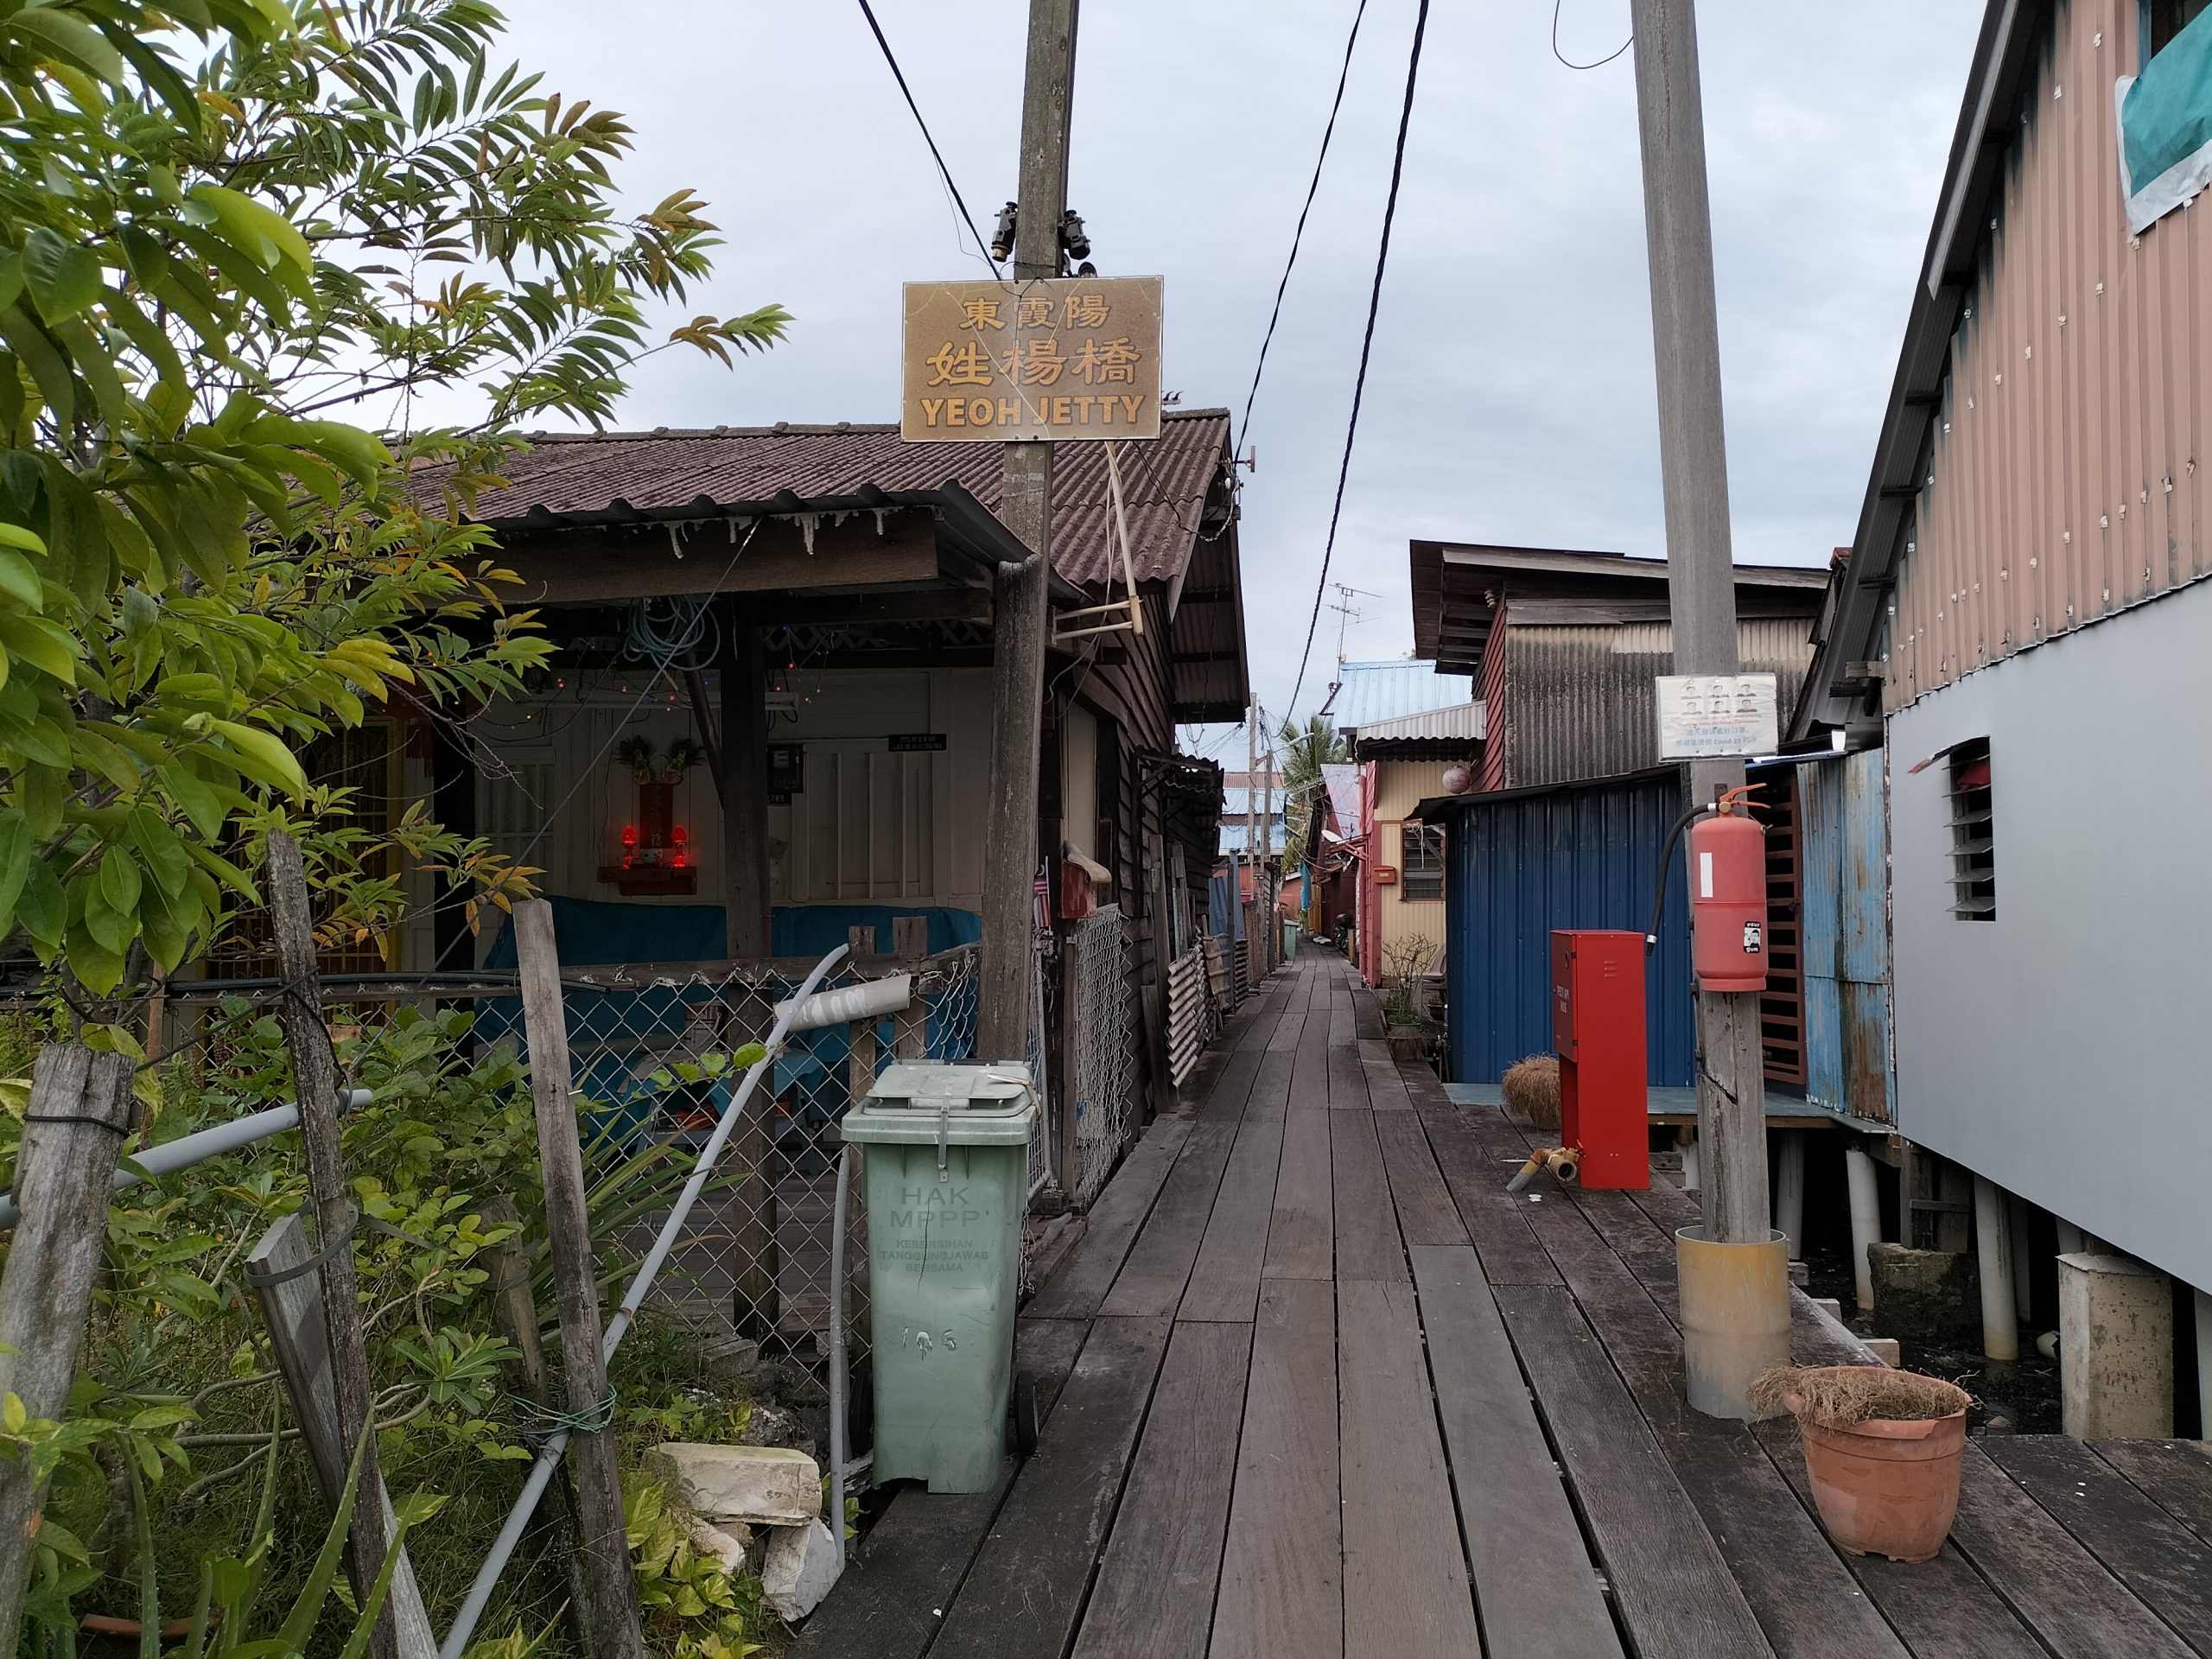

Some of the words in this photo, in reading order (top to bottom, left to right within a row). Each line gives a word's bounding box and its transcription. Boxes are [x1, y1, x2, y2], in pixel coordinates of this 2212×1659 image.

[959, 294, 1109, 330] 東霞陽
[925, 337, 1141, 386] 姓楊橋
[920, 397, 1021, 427] YEOH
[1032, 394, 1145, 425] JETTY
[901, 1186, 969, 1205] HAK
[890, 1210, 980, 1229] MPPP
[897, 1239, 973, 1249] KEBERSIHAN
[906, 1263, 964, 1272] BERSAMA
